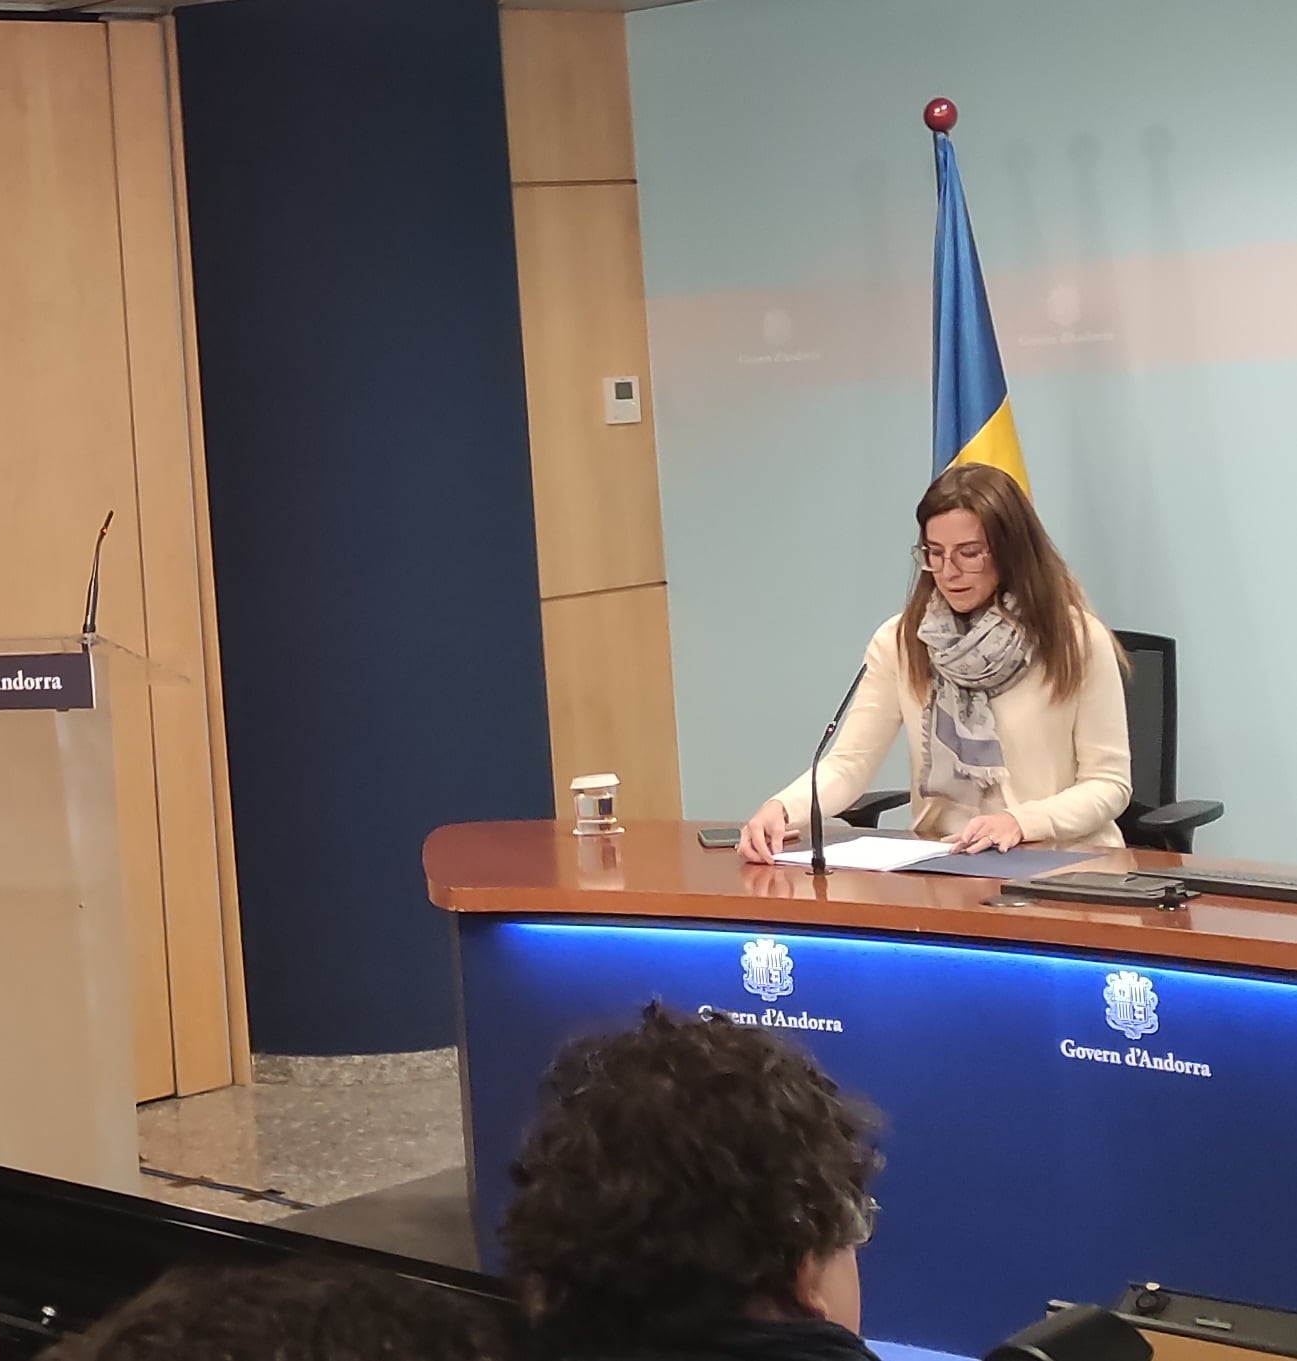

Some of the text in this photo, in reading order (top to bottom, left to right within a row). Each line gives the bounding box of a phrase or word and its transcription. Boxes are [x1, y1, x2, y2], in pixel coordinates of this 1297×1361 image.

[698, 1004, 843, 1032] Gern d’Andorra
[1060, 1039, 1212, 1077] Govern d’Andorra
